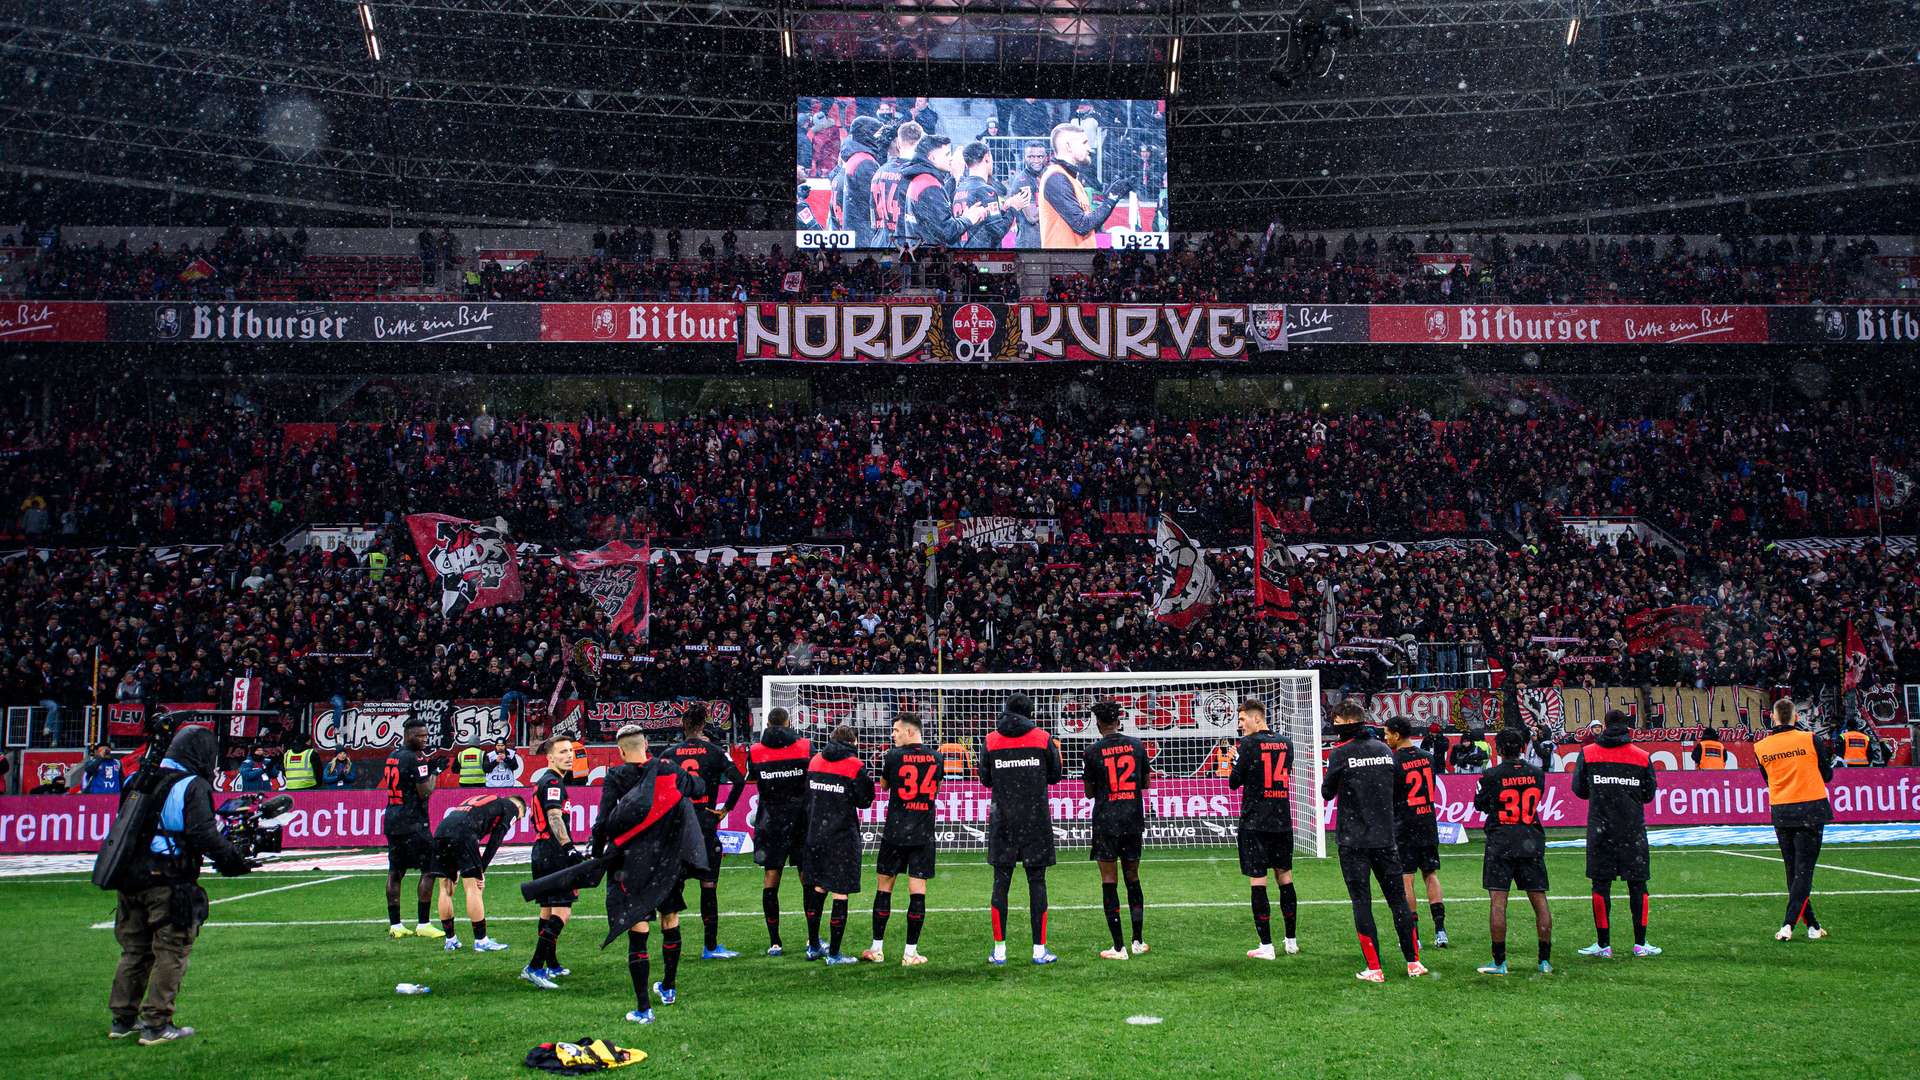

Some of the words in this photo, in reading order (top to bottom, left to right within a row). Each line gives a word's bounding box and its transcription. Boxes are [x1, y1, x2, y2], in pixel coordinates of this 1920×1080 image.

[803, 233, 850, 246] 90:00
[1120, 234, 1163, 247] 19:27
[191, 305, 348, 339] Bitburger
[374, 316, 416, 339] Bitte
[422, 315, 454, 330] ein
[458, 305, 494, 326] Bit
[745, 306, 933, 357] NORD
[1020, 306, 1247, 358] KURVE
[955, 320, 993, 328] BAYER
[1458, 307, 1601, 340] Bitburger
[1625, 318, 1665, 340] Bitte
[1669, 318, 1699, 332] ein
[1702, 307, 1735, 328] Bit
[1856, 307, 1920, 341] Bitb
[956, 339, 992, 362] 04
[456, 707, 510, 744] 513
[588, 701, 687, 720] JUGEN
[995, 756, 1040, 769] Barmenia
[1261, 752, 1290, 788] 14
[1347, 753, 1394, 768] Barmenia
[1762, 746, 1807, 763] Barmenia
[760, 767, 803, 780] Barmenia
[809, 779, 845, 794] Barmenia
[897, 764, 938, 801] 34
[1103, 755, 1136, 792] 12
[1405, 767, 1434, 807] 21
[1593, 774, 1640, 787] Barmenia
[1498, 787, 1541, 825] 30
[1655, 780, 1770, 815] remiu
[1834, 777, 1920, 813] anufa
[0, 804, 112, 842] remiu
[288, 801, 386, 837] actur
